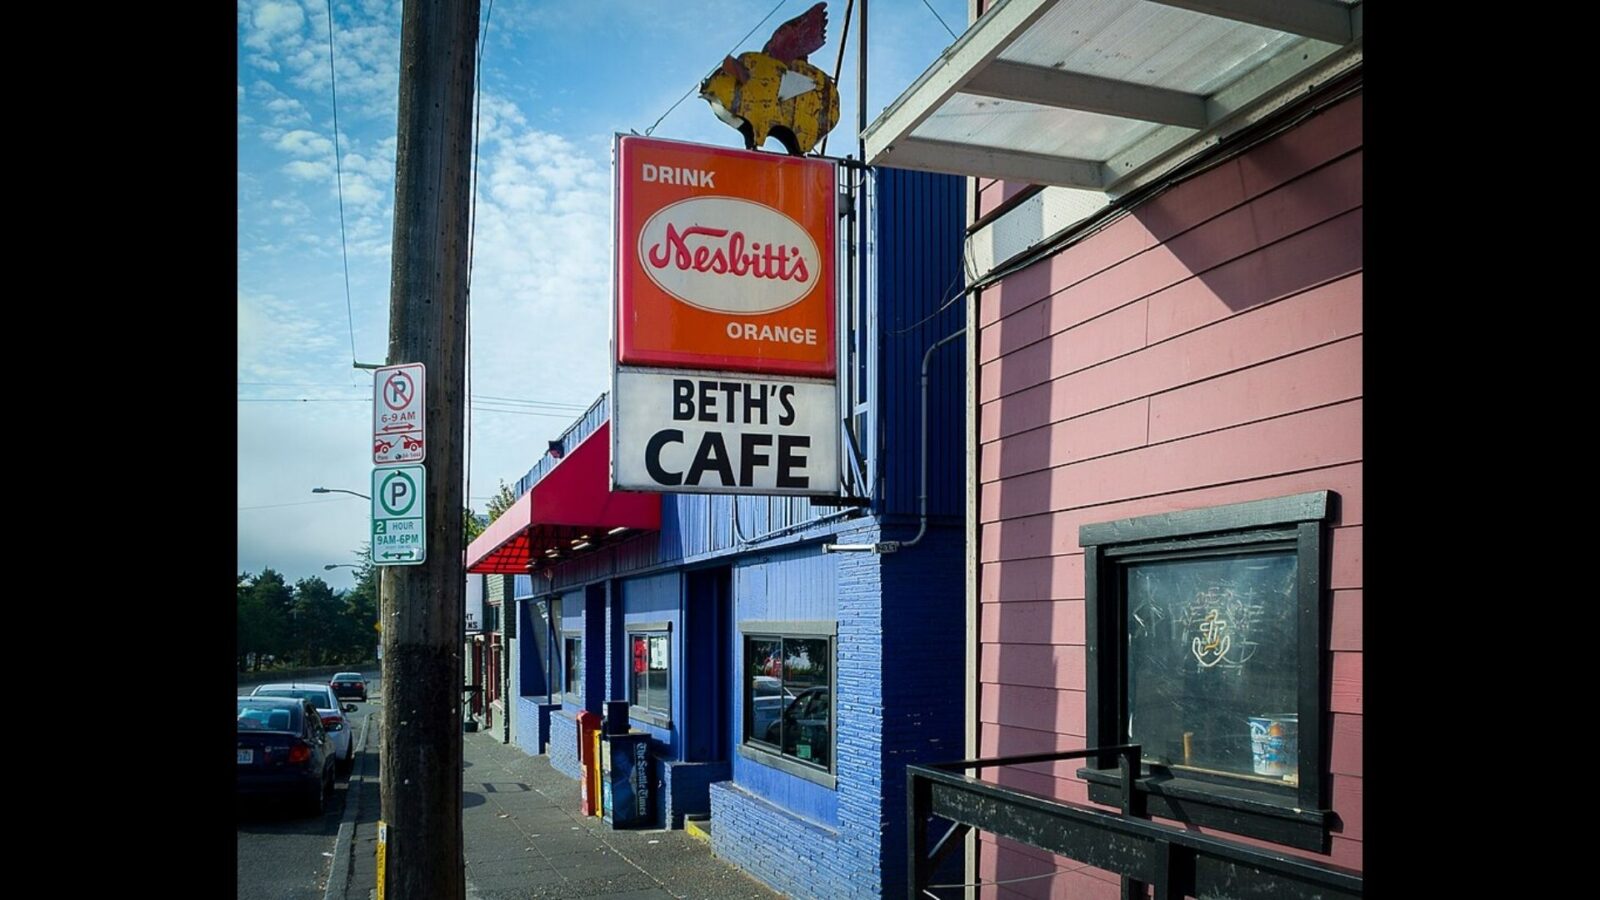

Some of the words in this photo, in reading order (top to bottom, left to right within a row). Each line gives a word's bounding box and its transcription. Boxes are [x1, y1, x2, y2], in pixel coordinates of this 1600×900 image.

[642, 164, 716, 188] DRINK
[649, 222, 809, 283] Nesbitt's
[727, 322, 817, 345] ORANGE
[673, 379, 795, 426] BETH'S
[381, 413, 398, 423] 6-9
[400, 411, 416, 420] AM
[645, 428, 811, 489] CAFE
[391, 482, 407, 506] P
[376, 521, 384, 533] 2
[392, 521, 414, 531] HOUR
[377, 534, 419, 545] 9AM-6PM
[636, 742, 647, 759] The
[637, 760, 648, 788] Seattle
[638, 789, 648, 816] Times
